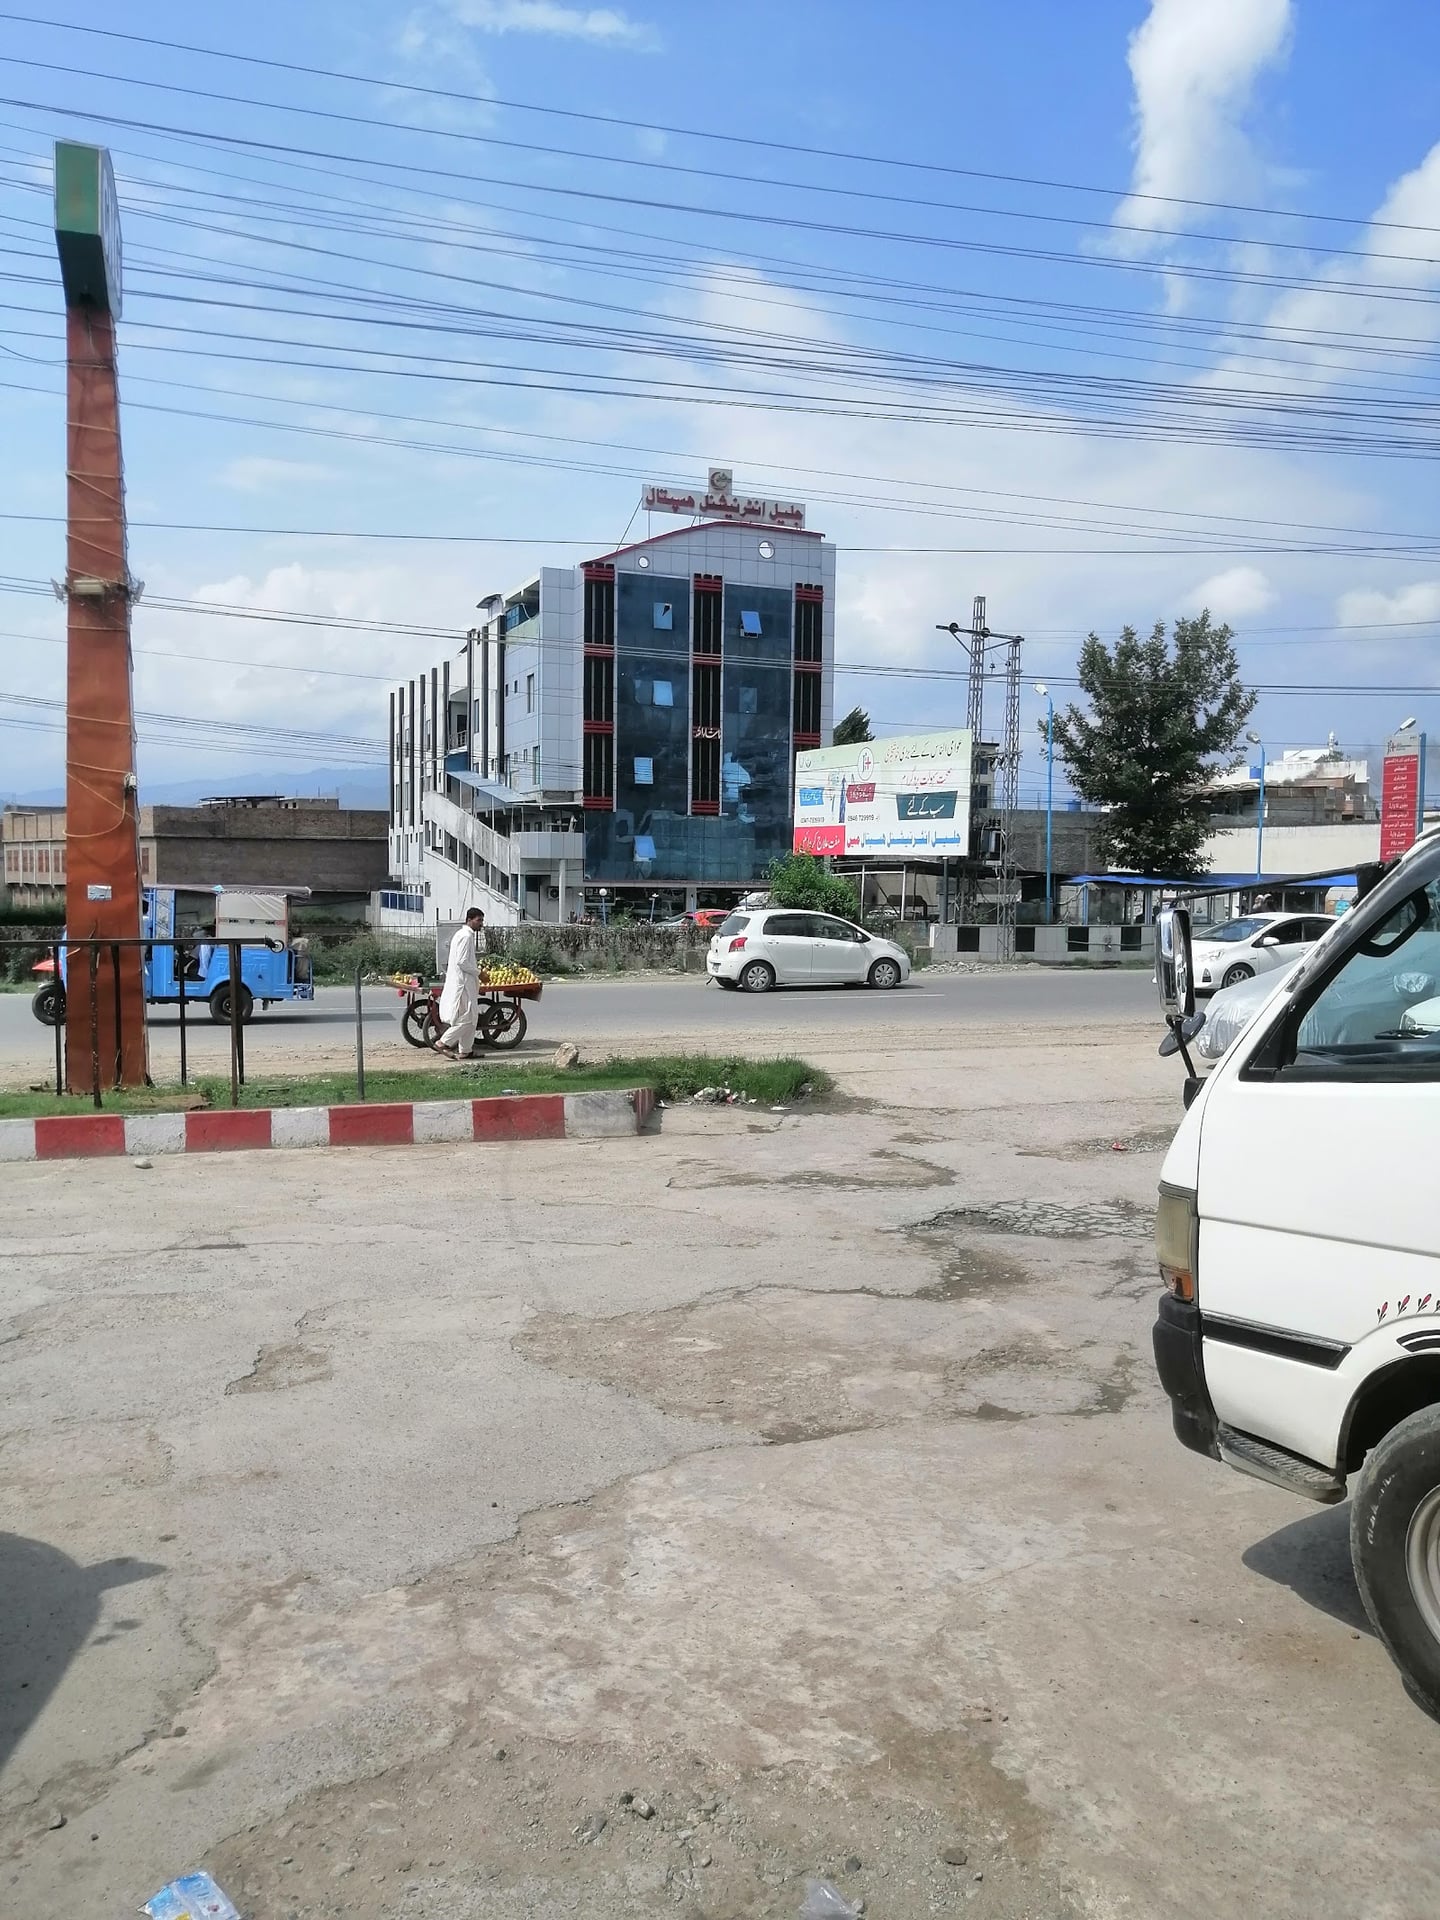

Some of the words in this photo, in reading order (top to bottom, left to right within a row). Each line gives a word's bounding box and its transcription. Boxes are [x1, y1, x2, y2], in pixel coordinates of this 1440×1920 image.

[699, 494, 766, 519] انٹرنیشنل
[769, 503, 803, 528] جلیل
[919, 796, 929, 815] کے
[930, 803, 945, 818] سب
[816, 835, 828, 851] علاج
[828, 835, 840, 849] مفت
[847, 836, 860, 848] میں
[886, 830, 930, 848] انٹرنیشنل
[931, 829, 961, 848] جلیل
